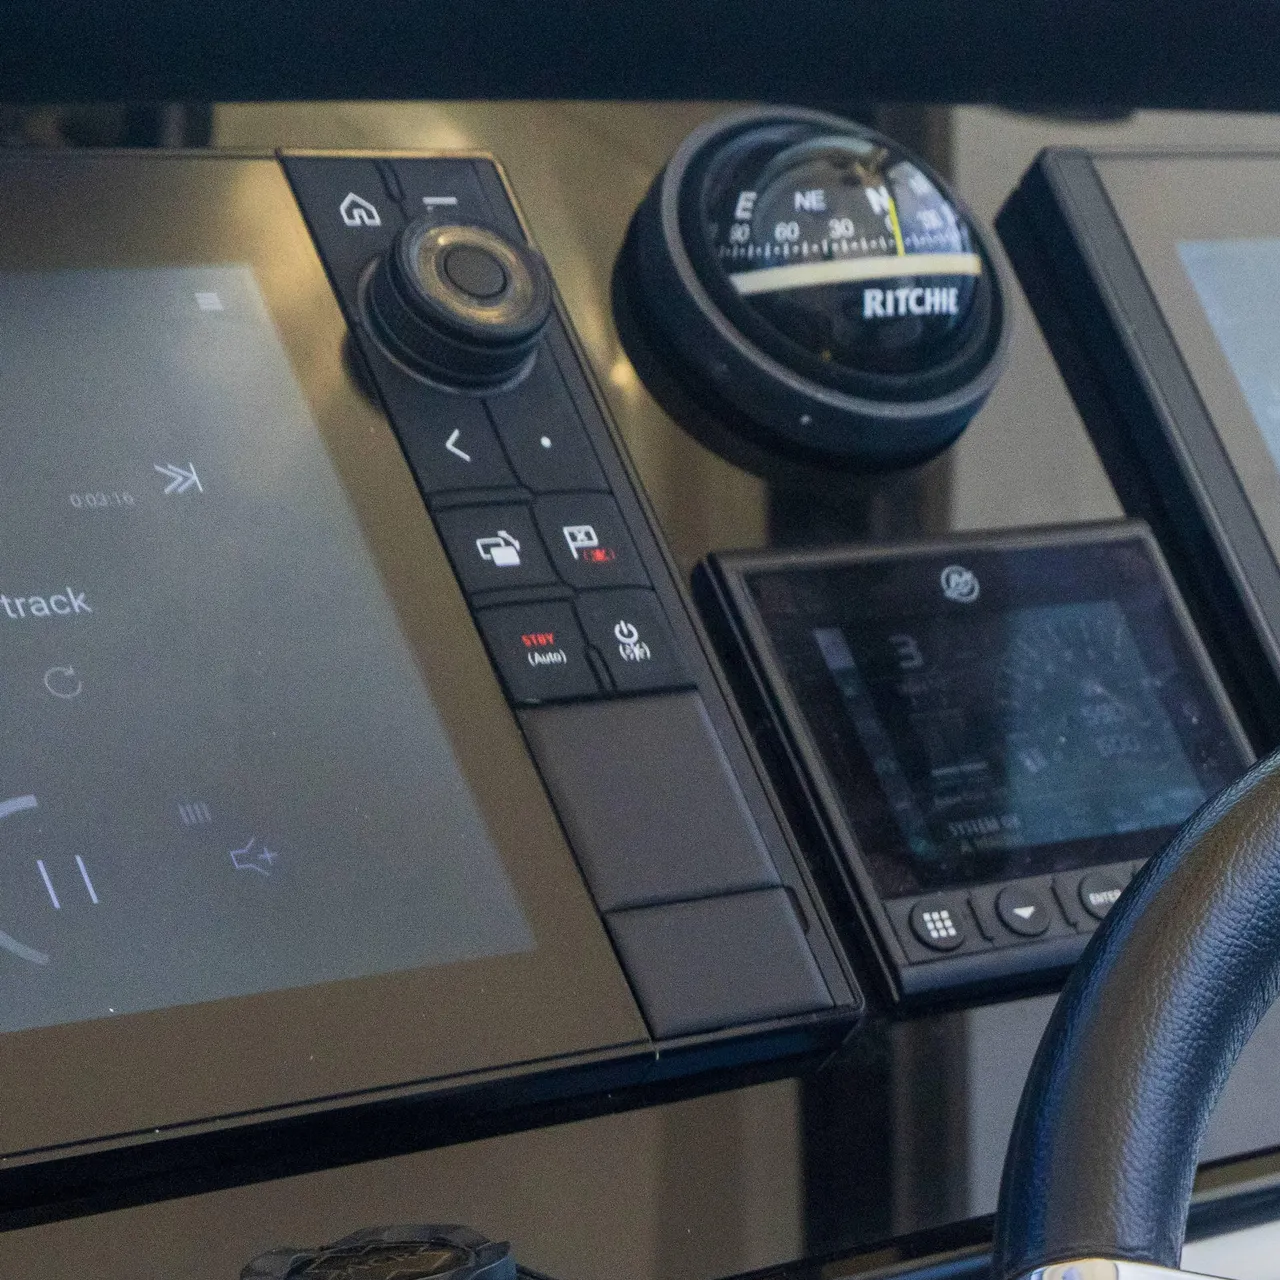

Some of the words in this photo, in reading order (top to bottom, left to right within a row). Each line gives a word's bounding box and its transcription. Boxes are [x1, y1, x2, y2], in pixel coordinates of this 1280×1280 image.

[734, 191, 758, 220] E
[794, 189, 826, 212] NE
[865, 184, 890, 216] N
[774, 221, 799, 242] 60
[828, 218, 854, 240] 30
[863, 286, 959, 319] RITCHIE
[0, 586, 93, 619] track
[521, 632, 555, 648] STBY
[527, 649, 567, 667] (Auto)
